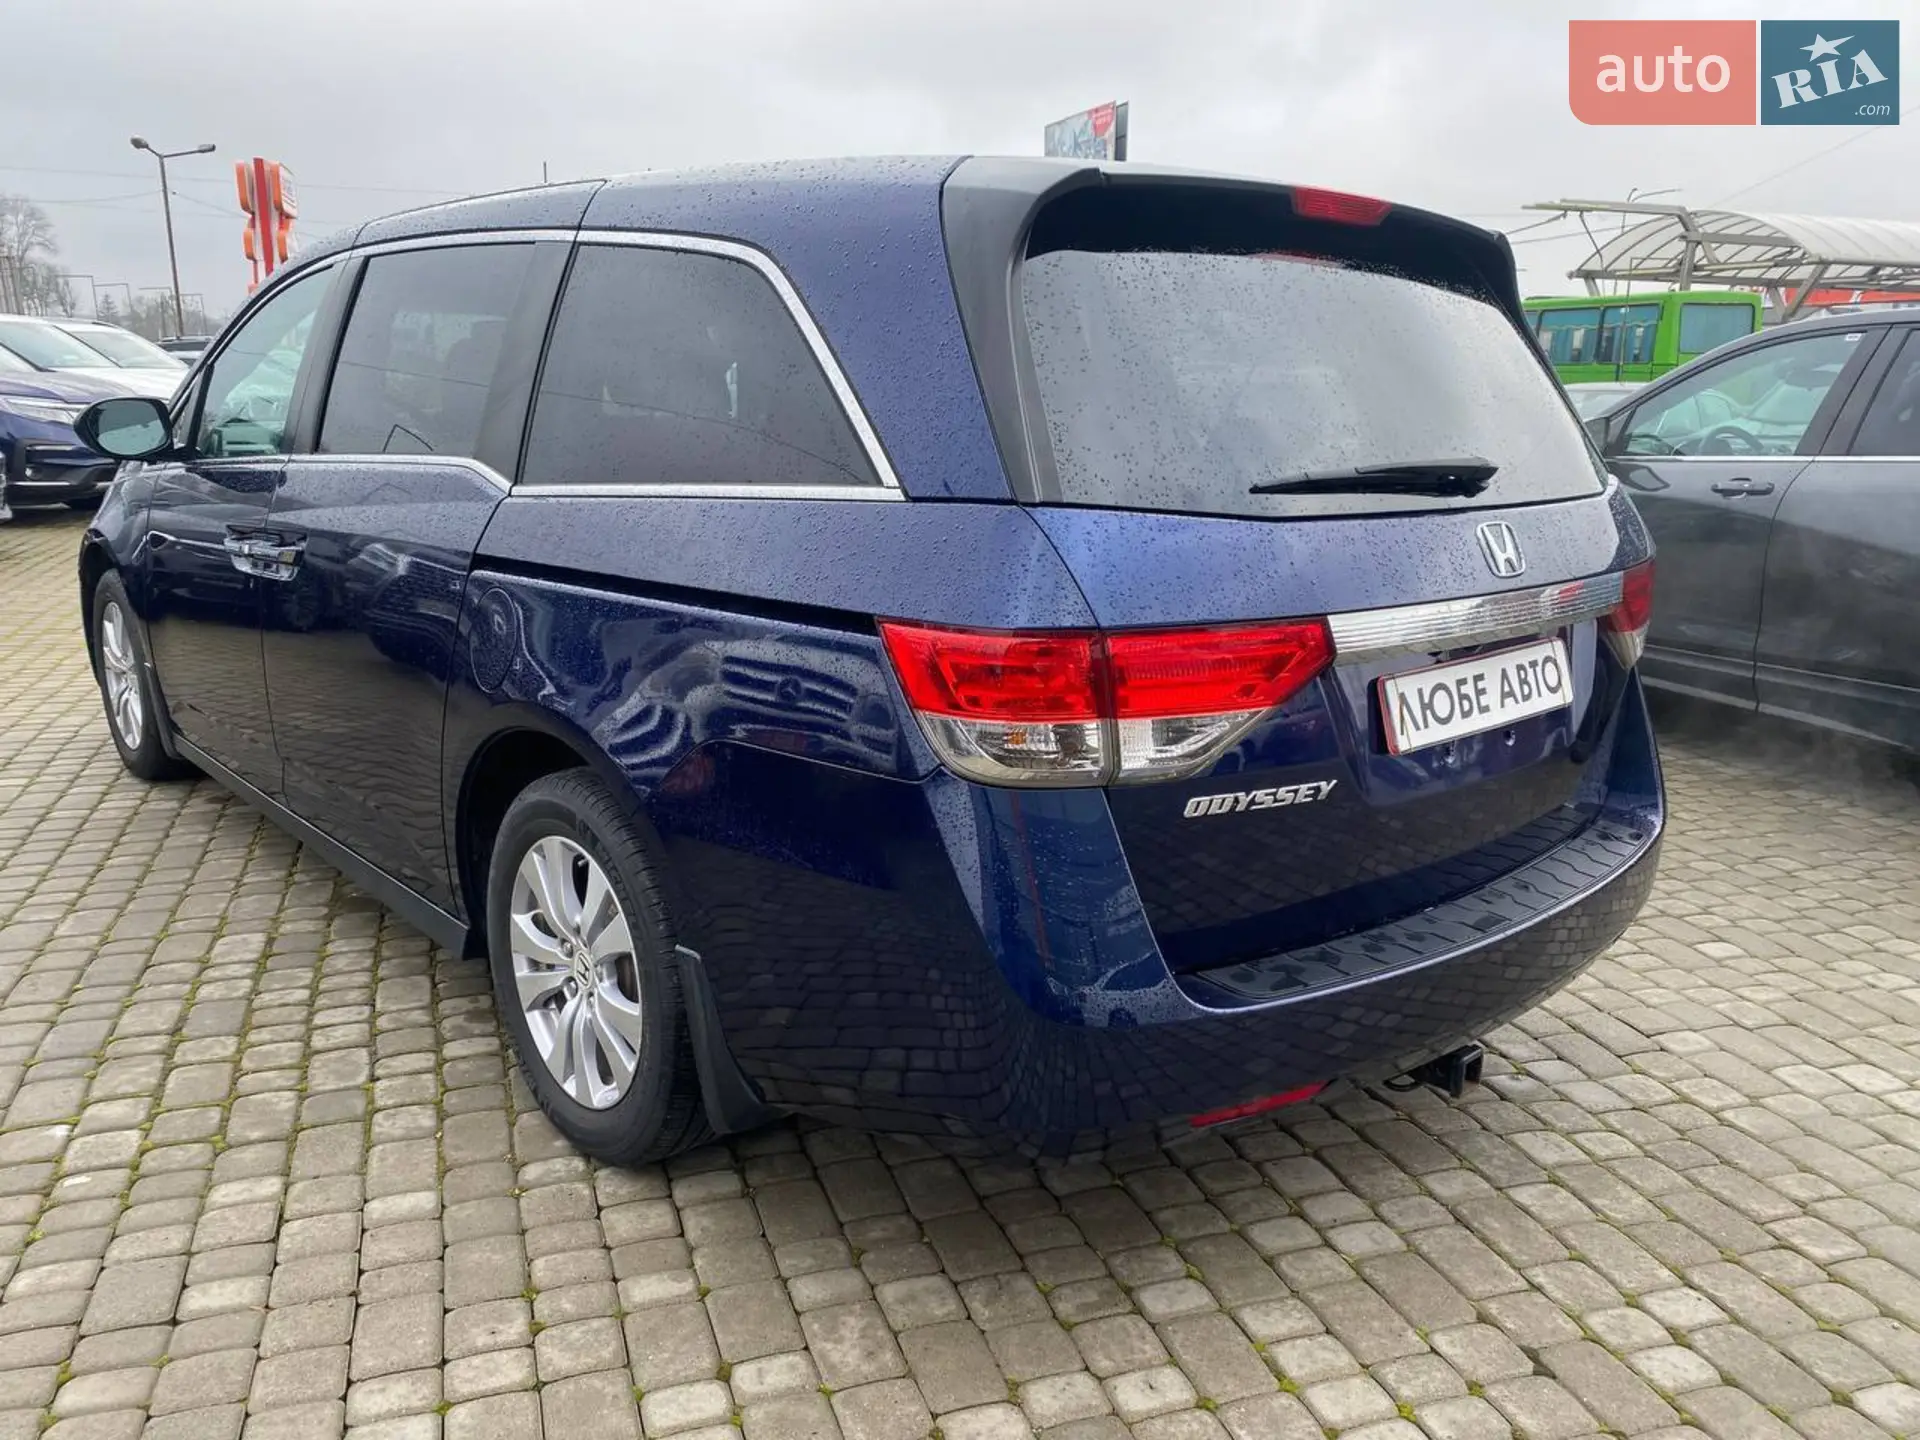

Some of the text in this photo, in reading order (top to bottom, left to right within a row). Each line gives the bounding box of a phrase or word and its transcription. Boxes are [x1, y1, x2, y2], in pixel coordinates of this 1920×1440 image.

[1399, 655, 1562, 735] ЛЮБЕ АВТО
[1183, 779, 1338, 818] ODYSSEY
